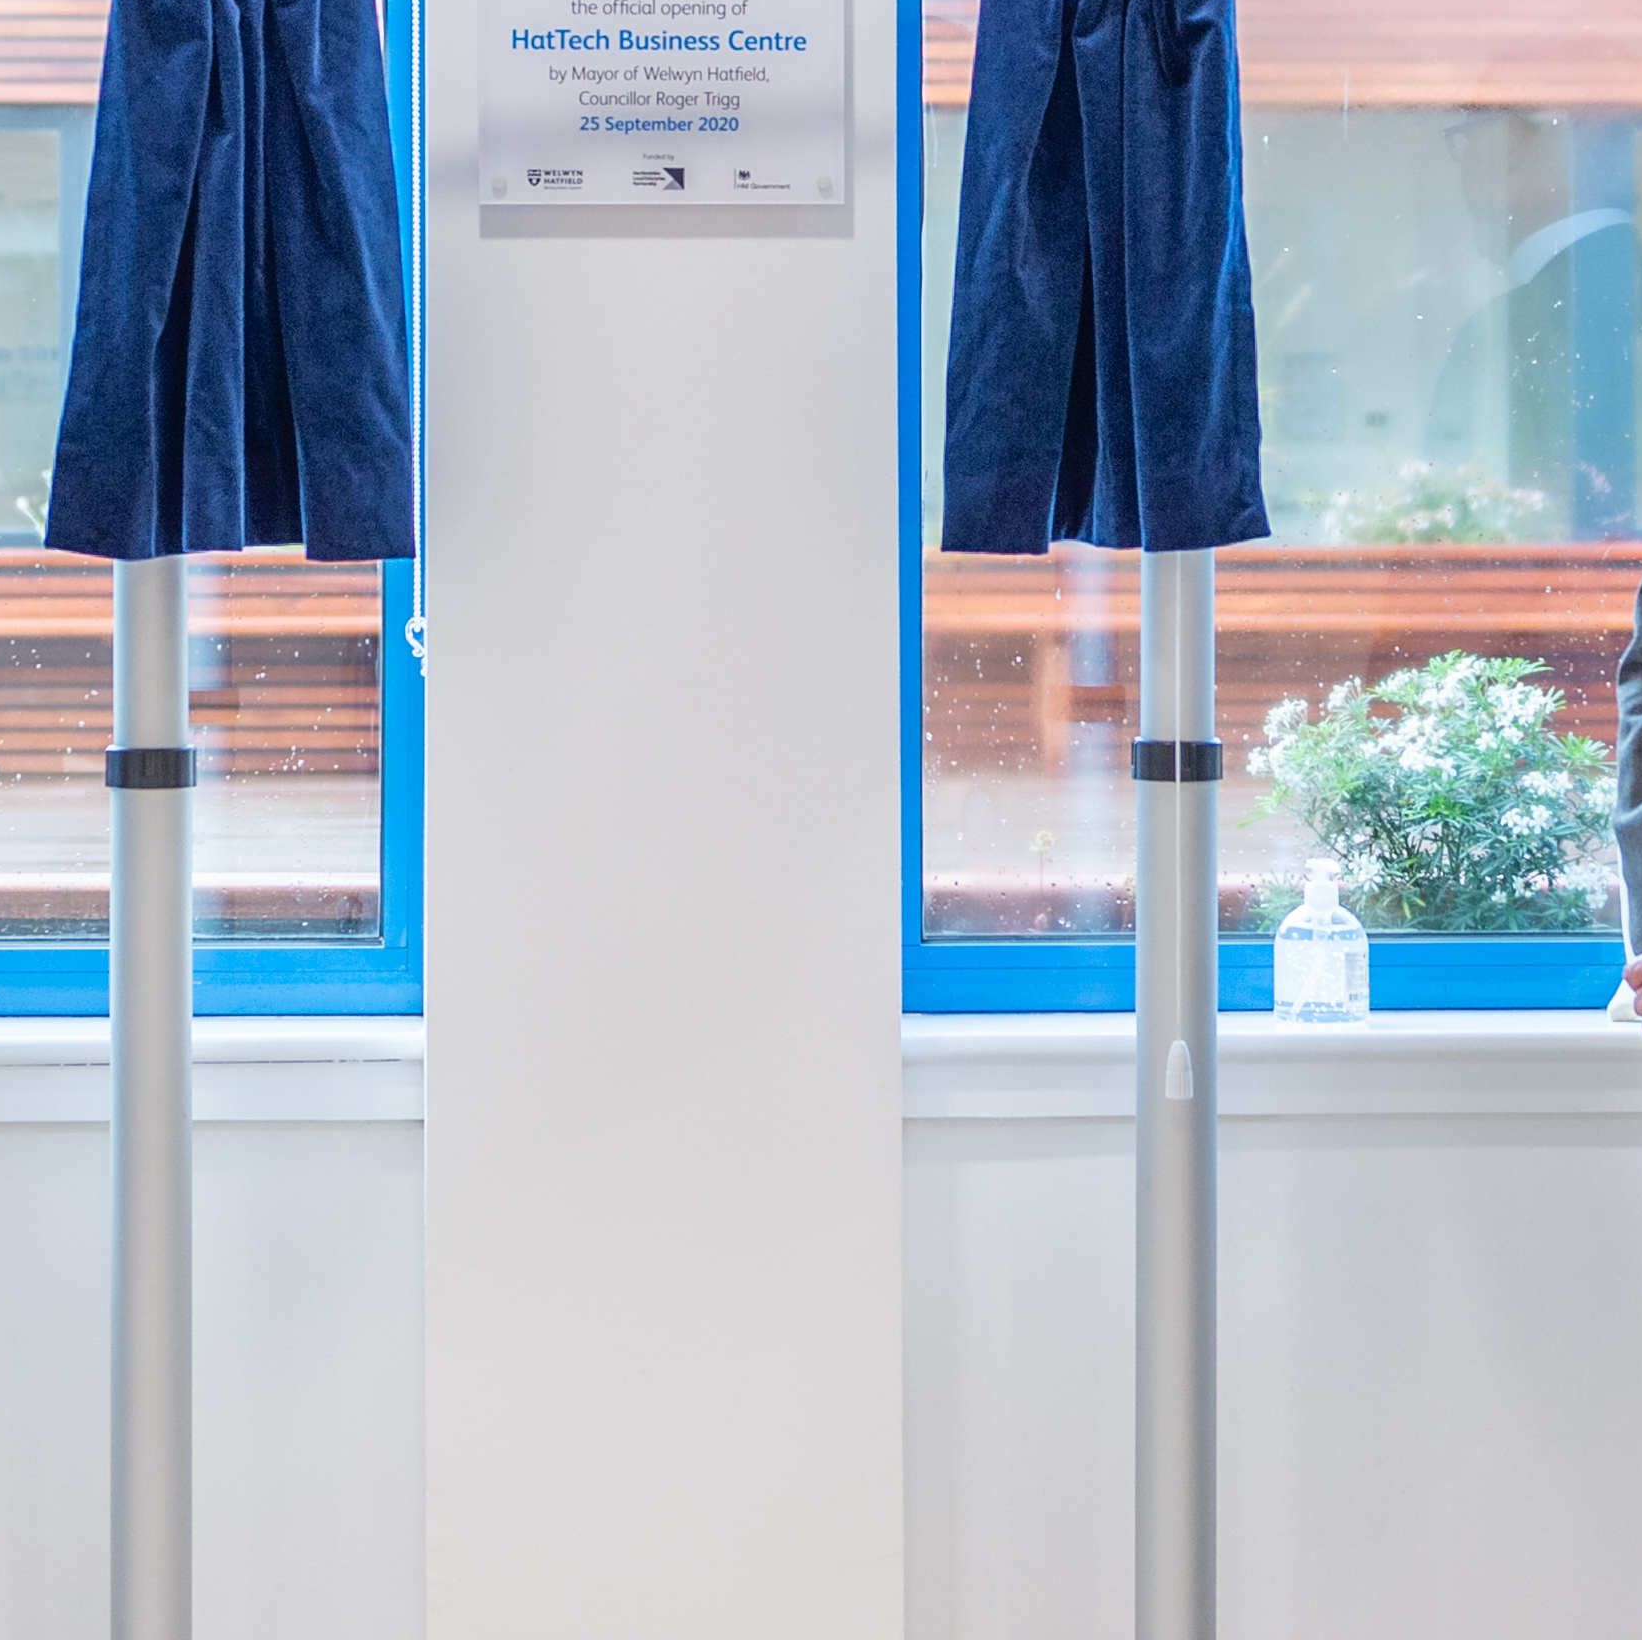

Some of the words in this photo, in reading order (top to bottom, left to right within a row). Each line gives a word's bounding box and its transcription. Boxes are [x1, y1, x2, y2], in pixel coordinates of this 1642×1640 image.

[660, 0, 727, 21] opening
[511, 29, 610, 51] HatTech
[618, 29, 721, 52] Business
[727, 30, 808, 52] Centre
[549, 65, 567, 85] by
[571, 65, 620, 85] Mayor
[623, 65, 640, 81] of
[642, 65, 703, 86] Welwyn
[707, 65, 770, 84] Hatfield,
[578, 90, 653, 107] Councillor
[655, 91, 700, 111] Roger
[702, 91, 741, 111] Trigg
[579, 115, 601, 132] 25
[604, 115, 694, 136] September
[697, 116, 740, 132] 2020
[642, 152, 665, 161] Funded
[666, 152, 675, 162] by
[543, 169, 584, 177] WELWYN
[543, 177, 584, 185] HATFIELD
